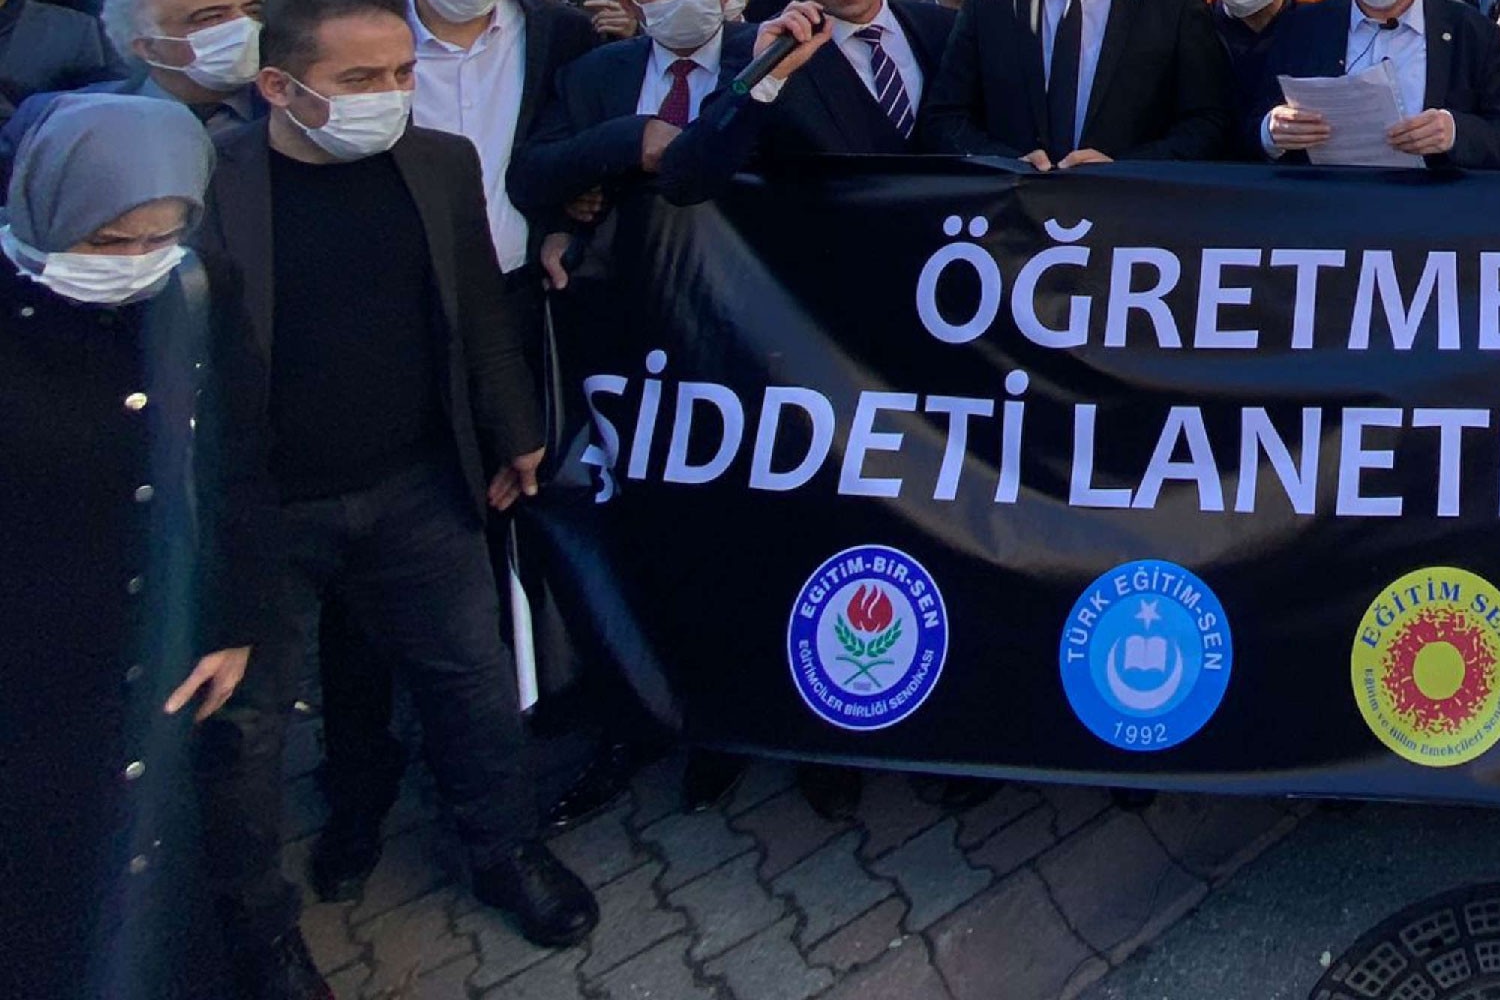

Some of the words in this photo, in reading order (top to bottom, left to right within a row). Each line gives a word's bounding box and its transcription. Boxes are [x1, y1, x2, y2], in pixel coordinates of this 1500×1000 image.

[580, 349, 1028, 504] ŞİDDETİ
[801, 555, 940, 628] EĞİTİM-BİR-SEN
[1066, 589, 1111, 664] TÜRK
[1114, 565, 1223, 670] EĞİTİM-SEN
[1362, 577, 1460, 648] EĞİTİM
[798, 639, 843, 712] EĞİTİMCİLER
[843, 702, 888, 718] BİRLİĞİ
[888, 649, 934, 710] SENDİKASI
[1114, 720, 1168, 745] 1992
[1377, 713, 1389, 729] ve
[1389, 725, 1417, 751] Bilim
[1420, 731, 1483, 757] Emekçileri
